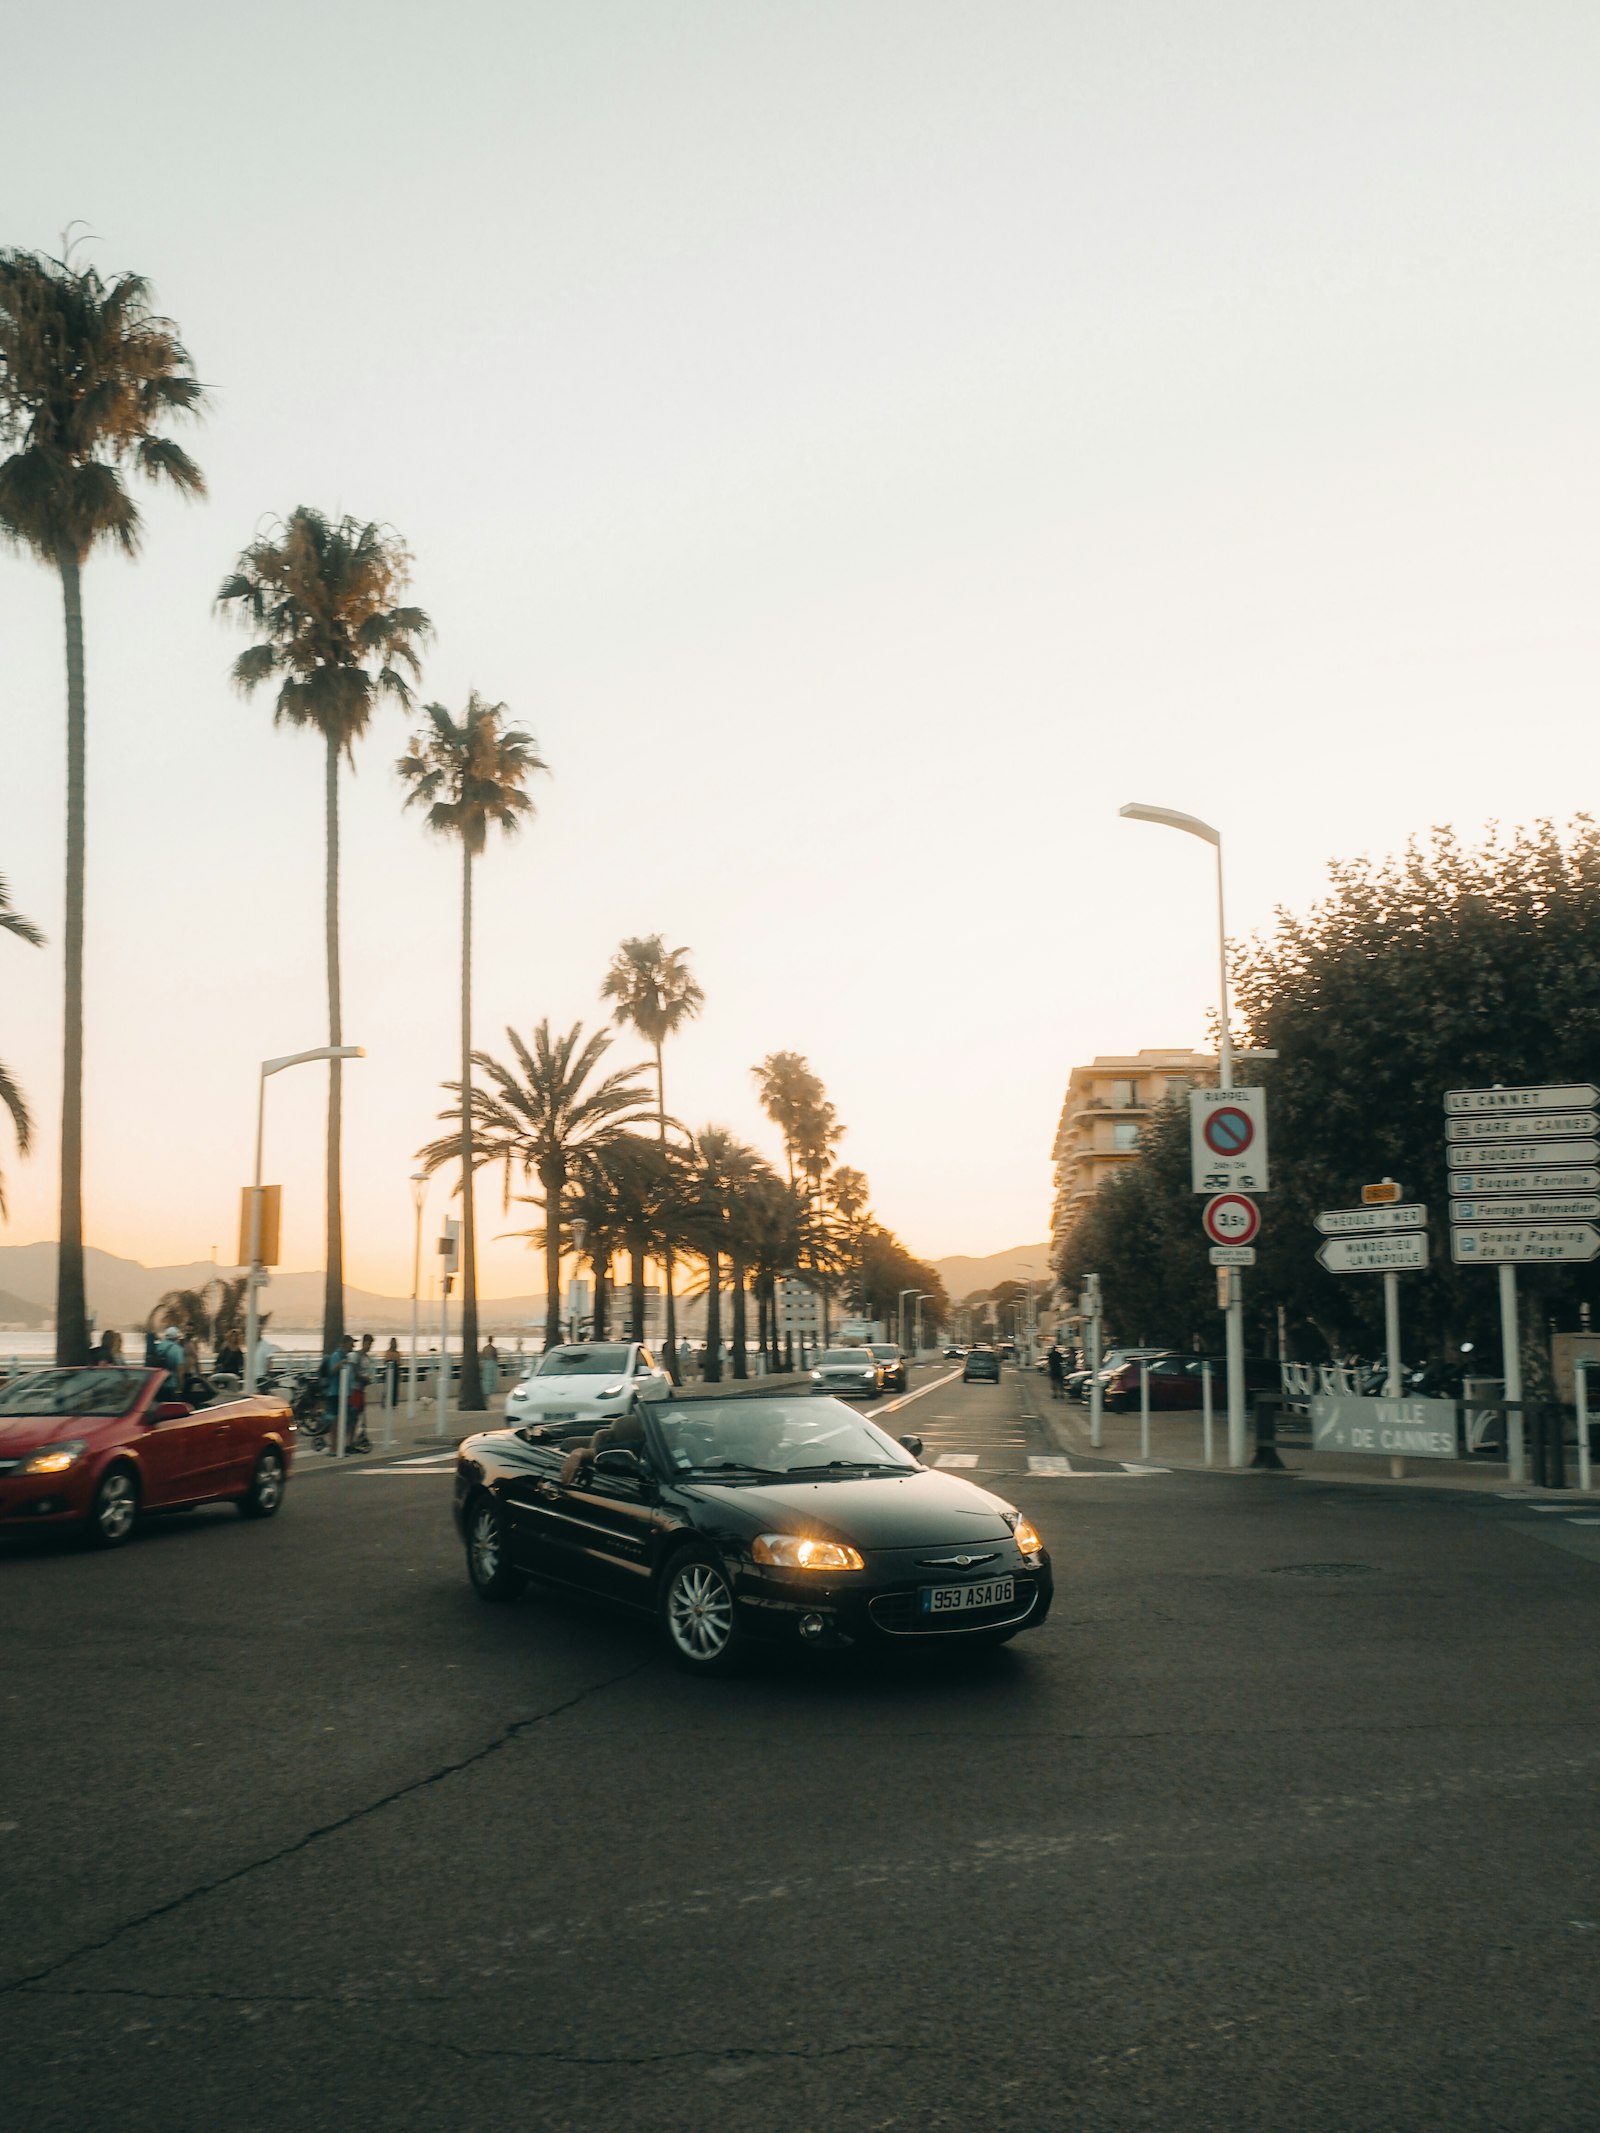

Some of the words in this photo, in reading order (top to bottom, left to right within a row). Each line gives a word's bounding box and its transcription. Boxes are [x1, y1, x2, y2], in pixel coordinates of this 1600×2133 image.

[1204, 1091, 1251, 1101] RAPPEL
[1453, 1097, 1471, 1108] LE
[1477, 1093, 1540, 1106] CANNET
[1473, 1121, 1512, 1134] GARE
[1534, 1118, 1592, 1131] CANNES
[1455, 1151, 1472, 1162] LE
[1478, 1148, 1537, 1161] SUQUET
[1476, 1178, 1527, 1190] Suquet
[1479, 1231, 1523, 1243] Grand
[1528, 1230, 1585, 1244] Parking
[1523, 1244, 1564, 1258] Plage
[1375, 1403, 1426, 1424] VILLE
[1352, 1428, 1375, 1448] DE
[1380, 1429, 1452, 1452] CANNES
[934, 1589, 962, 1609] 953
[965, 1585, 992, 1606] ASA
[994, 1582, 1012, 1602] 06
